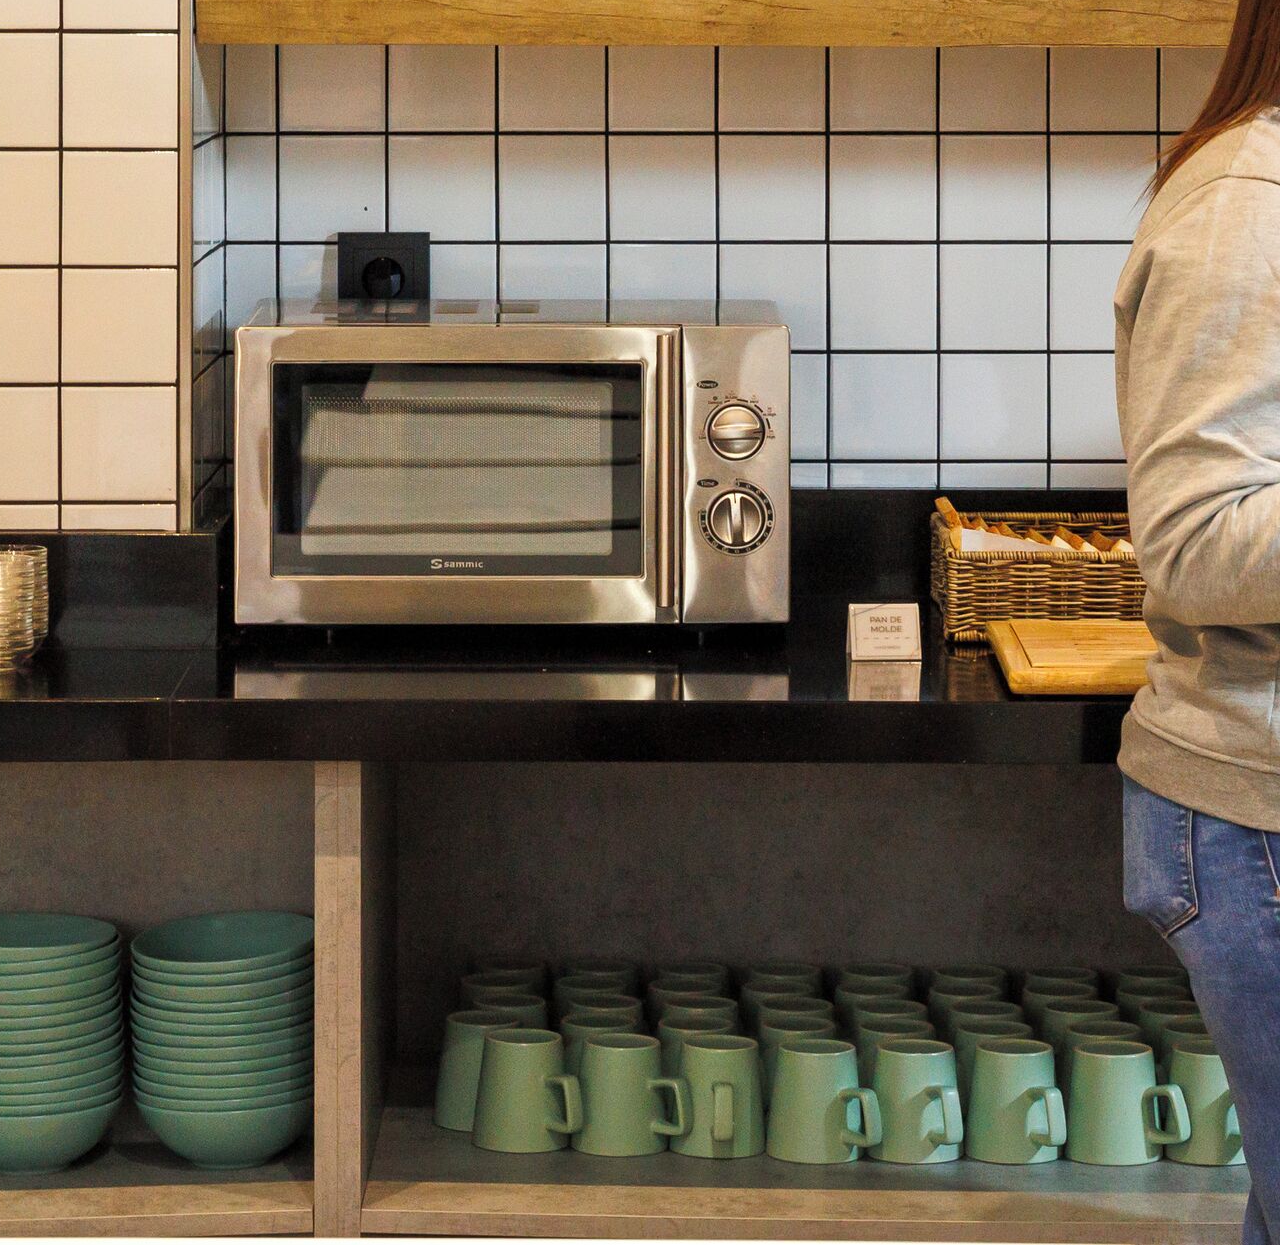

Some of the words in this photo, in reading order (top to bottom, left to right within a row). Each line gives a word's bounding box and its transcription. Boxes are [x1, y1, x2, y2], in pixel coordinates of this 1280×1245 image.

[443, 560, 484, 569] sammic
[869, 615, 888, 623] PAN
[890, 615, 903, 623] DE
[870, 625, 903, 633] MOLDE
